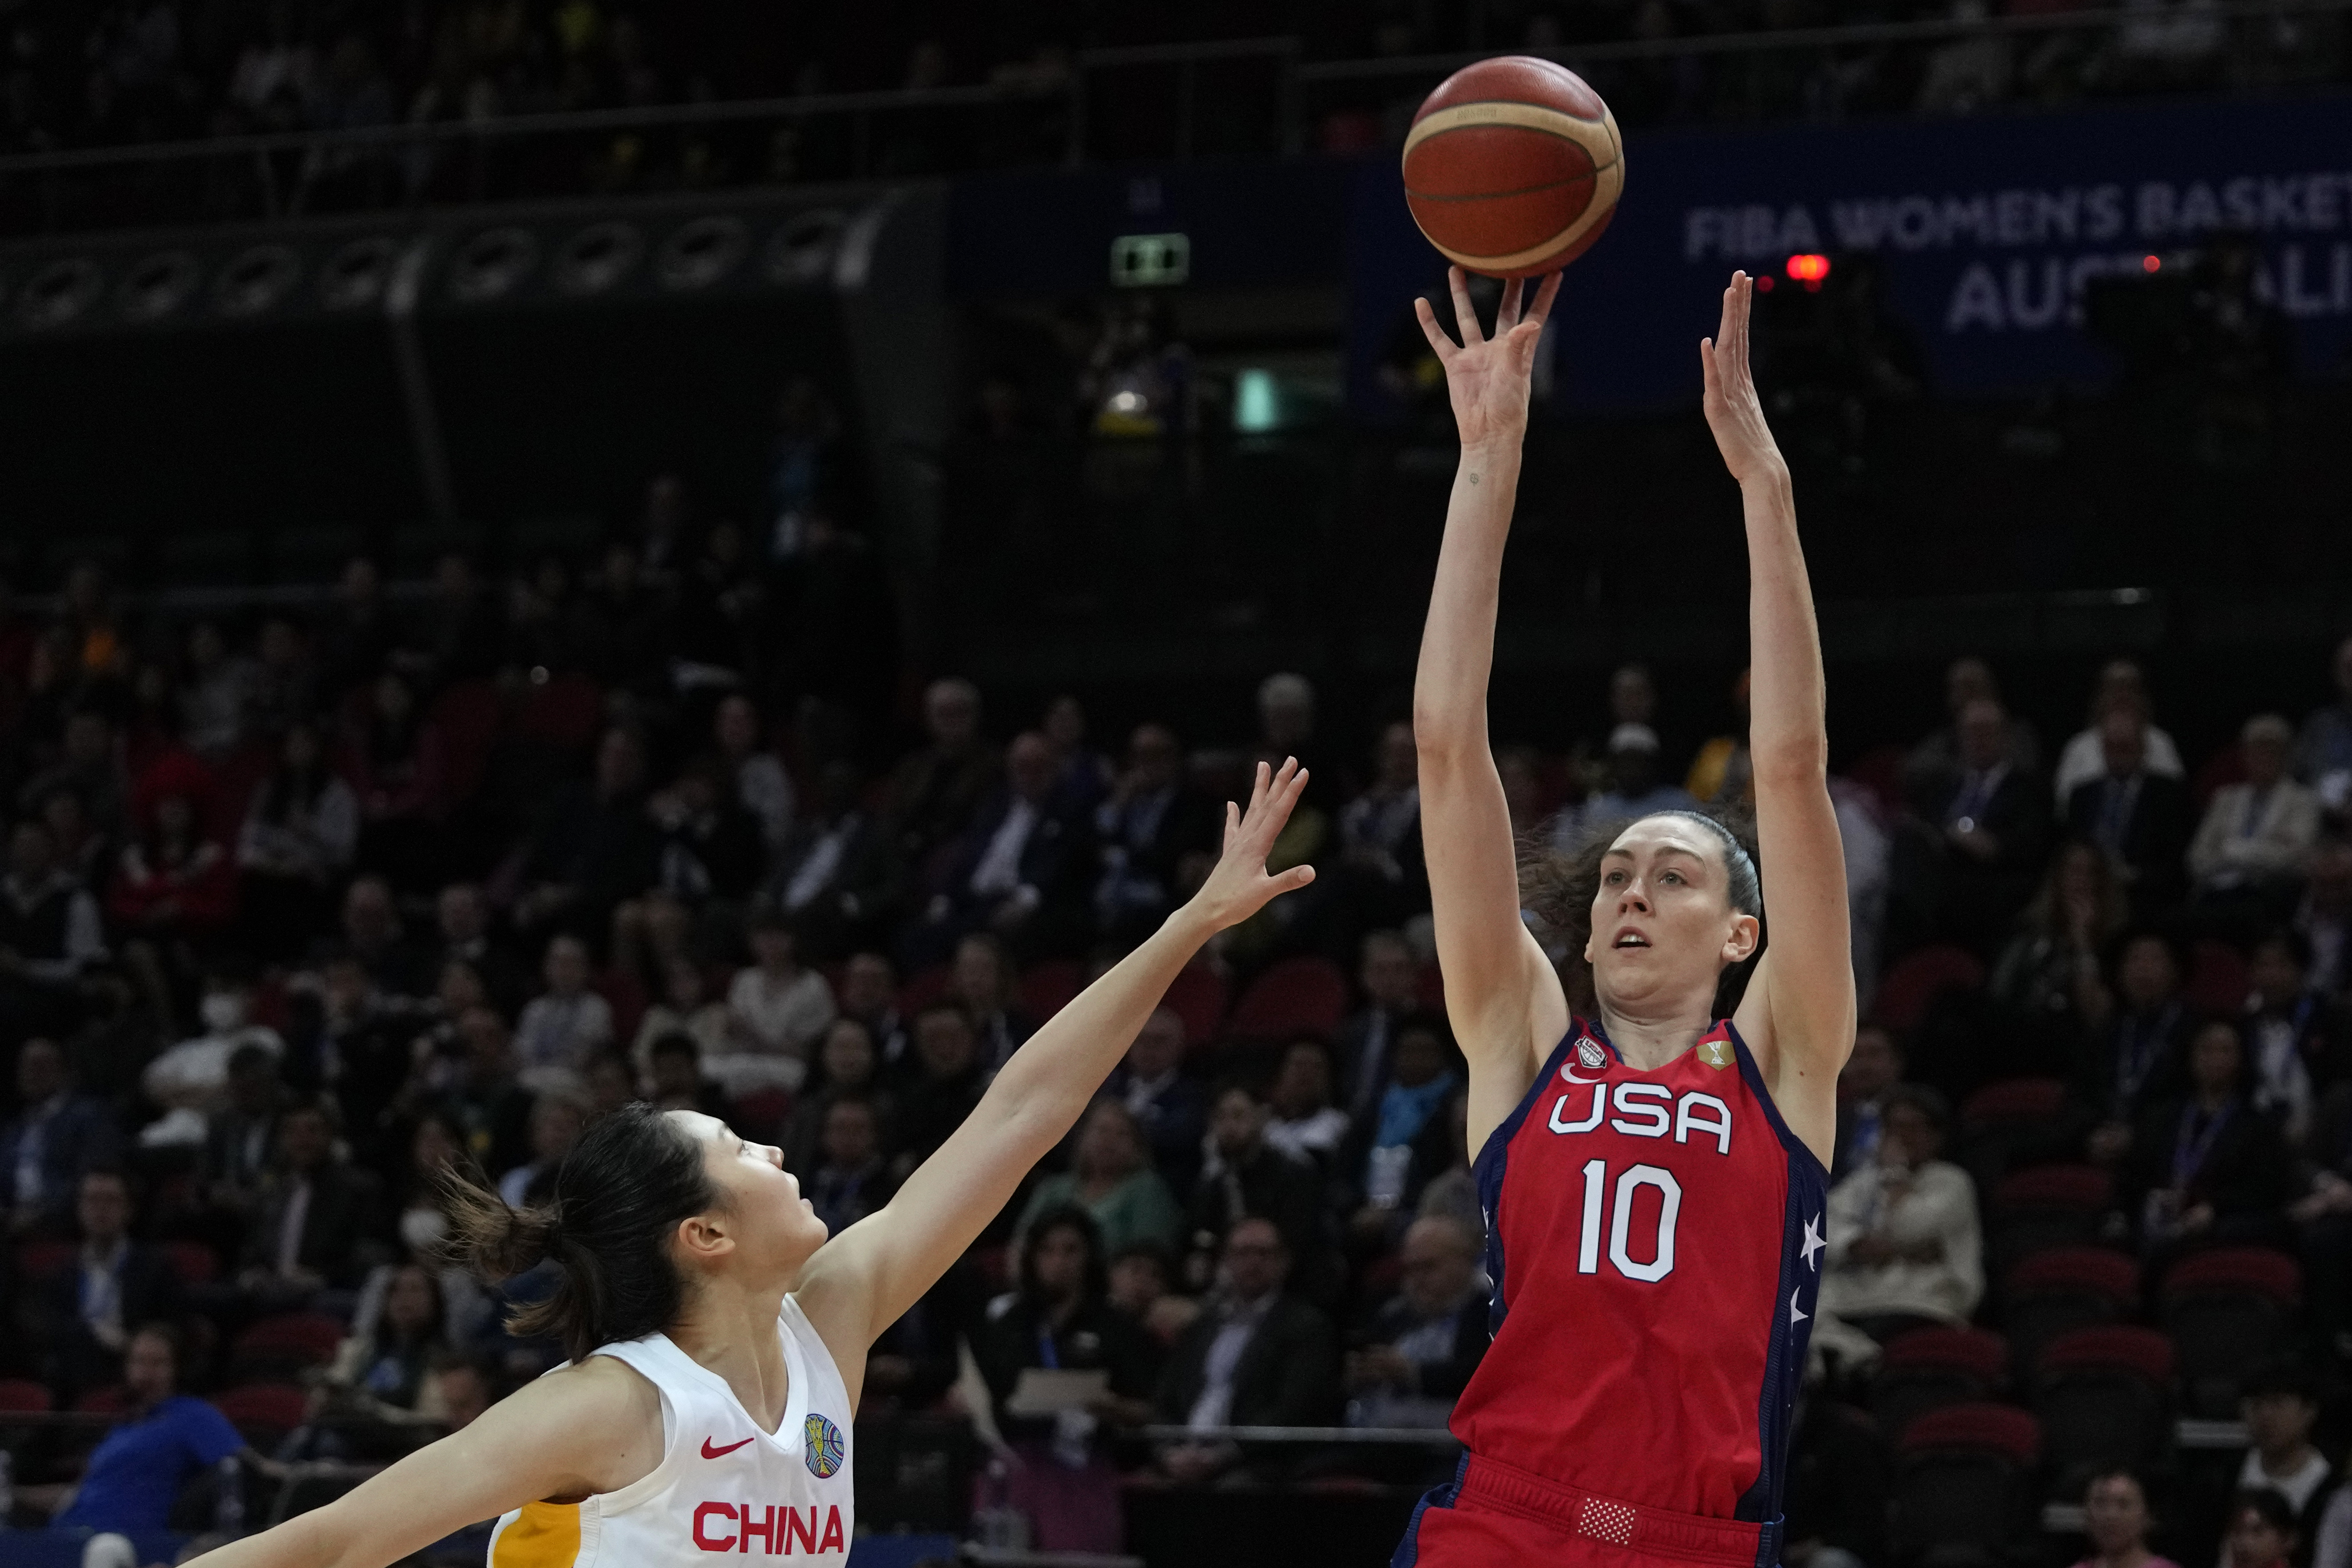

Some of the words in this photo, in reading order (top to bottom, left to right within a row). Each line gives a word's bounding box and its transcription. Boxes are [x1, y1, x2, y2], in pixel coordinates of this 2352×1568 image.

[1687, 203, 1821, 259] FIBA
[2138, 172, 2352, 235] BASKE
[1548, 1082, 1731, 1156] USA
[1578, 1158, 1682, 1283] 10
[693, 1501, 844, 1555] CHINA
